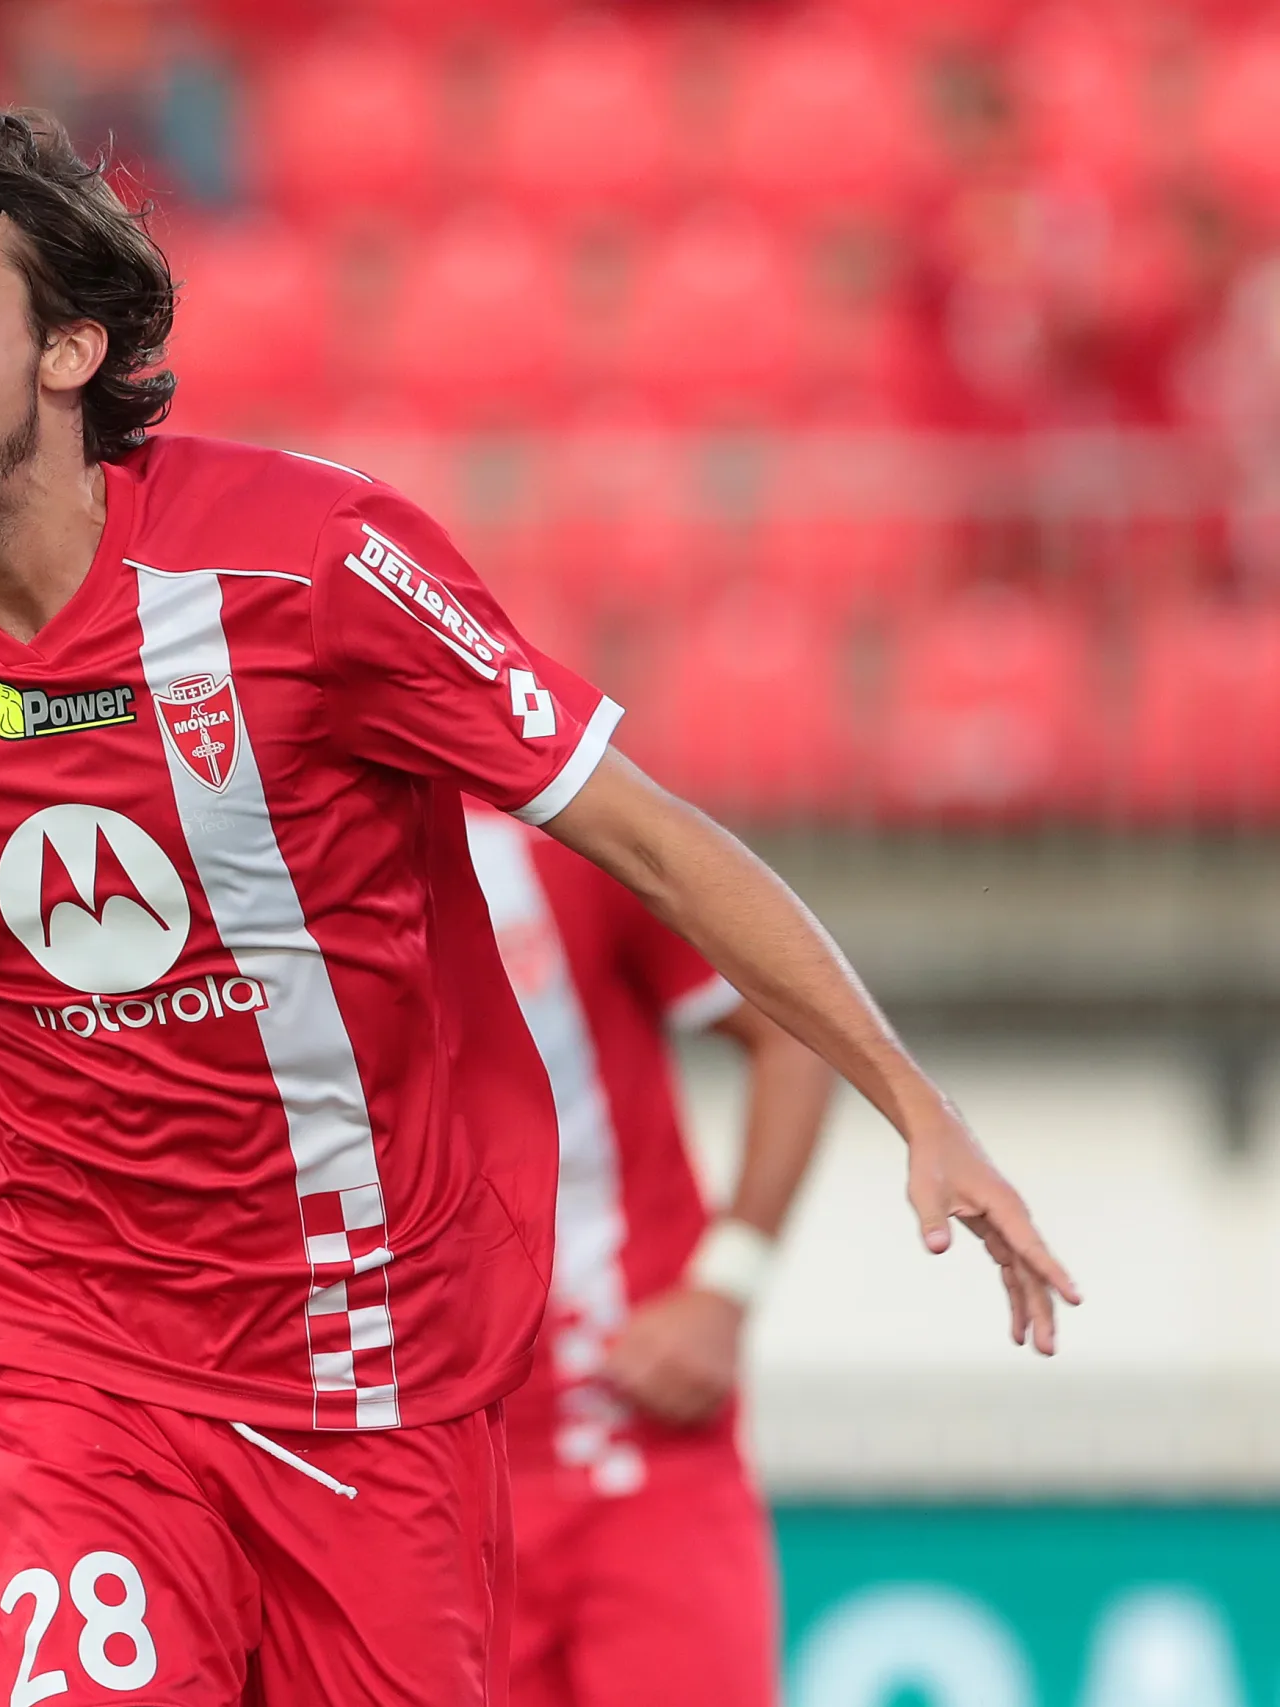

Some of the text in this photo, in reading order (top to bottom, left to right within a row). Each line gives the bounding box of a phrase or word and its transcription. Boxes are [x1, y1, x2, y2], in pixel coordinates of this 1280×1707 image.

[174, 710, 231, 735] MONZA
[190, 703, 208, 718] AC
[0, 1550, 158, 1707] 28
